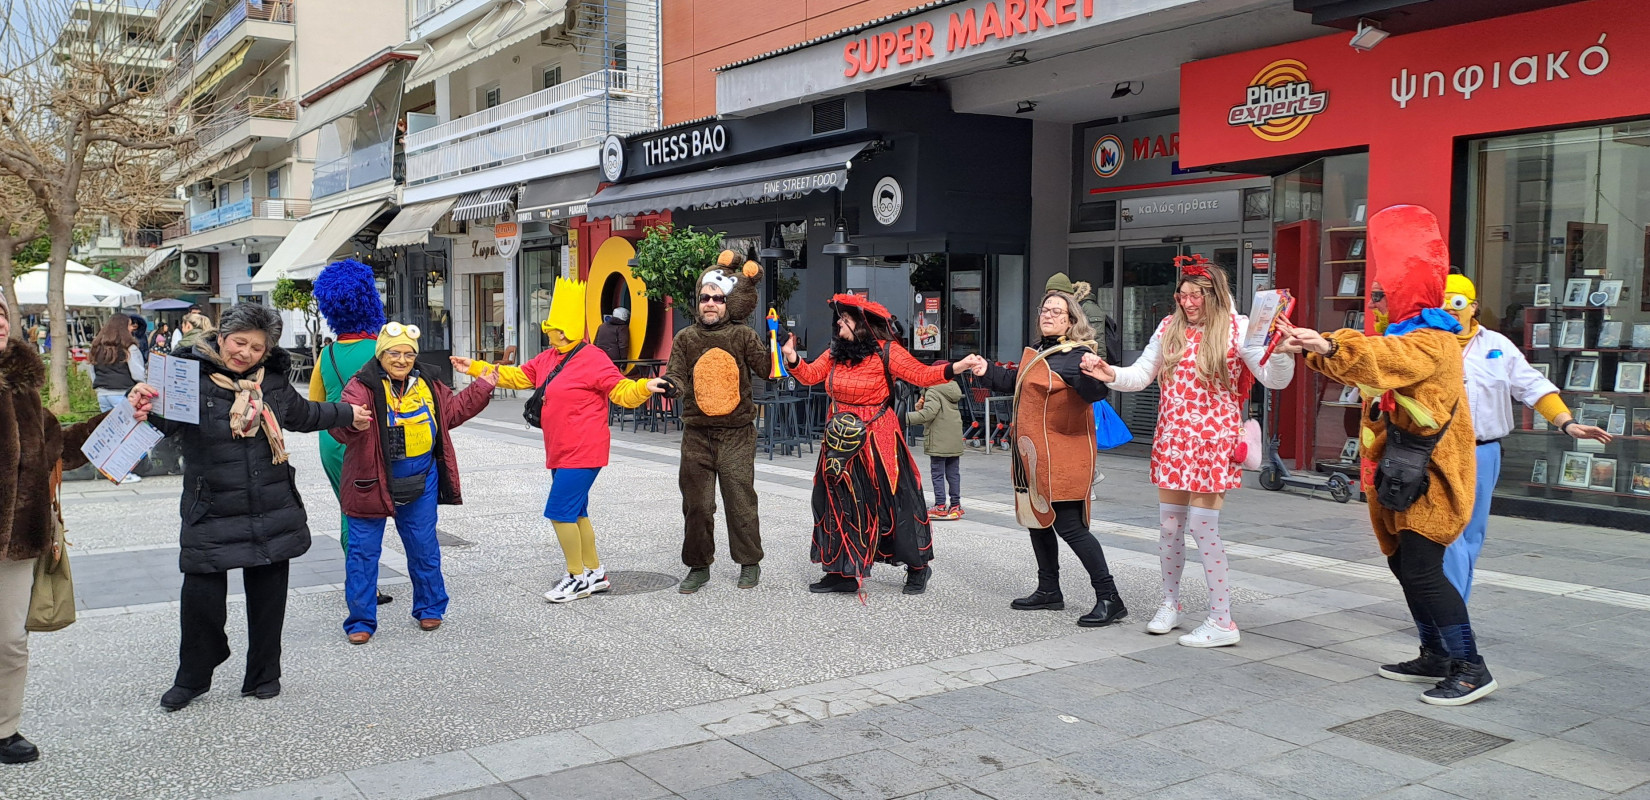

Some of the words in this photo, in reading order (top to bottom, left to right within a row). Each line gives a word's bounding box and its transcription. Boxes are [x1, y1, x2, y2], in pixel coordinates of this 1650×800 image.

[843, 20, 935, 77] SUPER
[1391, 32, 1610, 109] ψηφιακό
[1247, 82, 1310, 106] Photo
[1230, 96, 1322, 122] experts
[642, 132, 688, 166] THESS
[691, 124, 726, 157] BAO
[763, 181, 780, 194] FINE
[782, 176, 810, 191] STREET
[812, 172, 837, 188] FOOD
[1138, 201, 1175, 214] καλώς
[1177, 198, 1219, 214] ήρθατε
